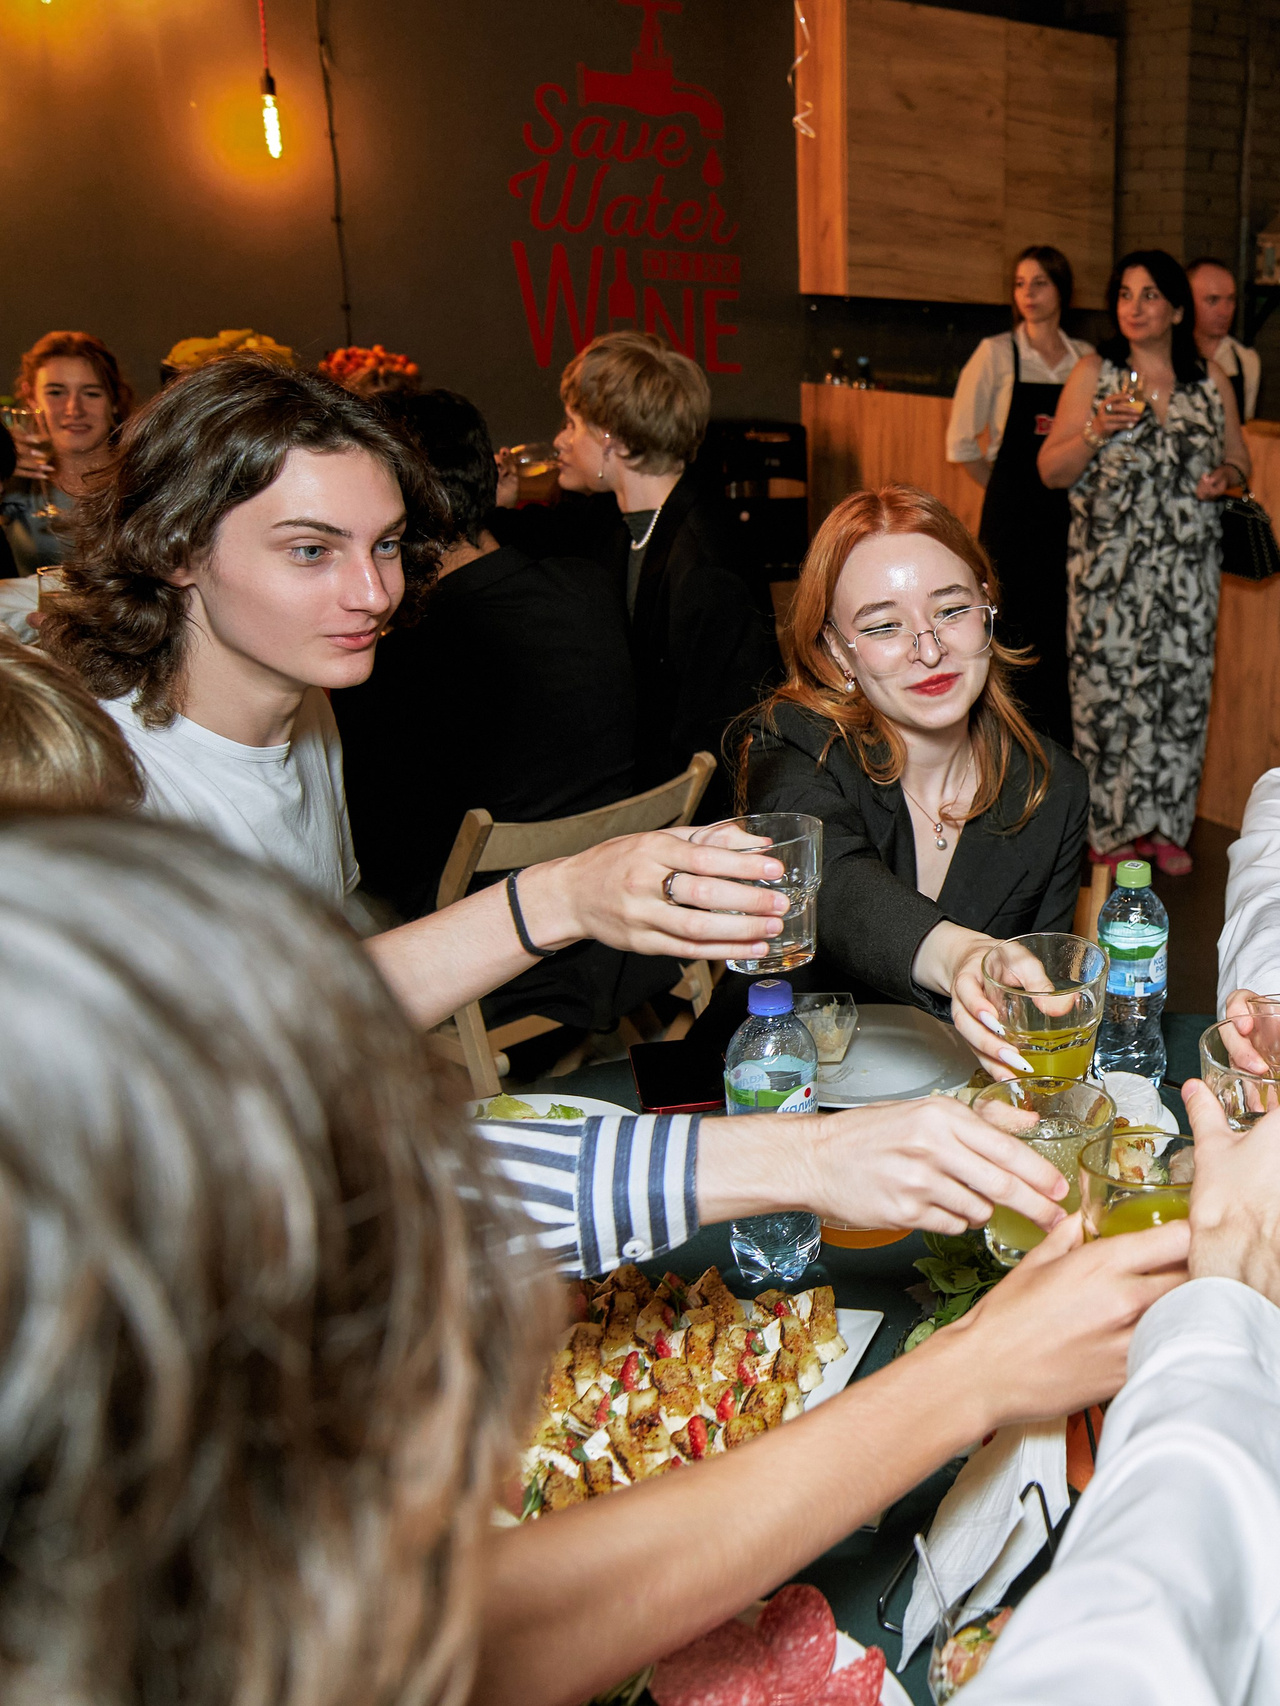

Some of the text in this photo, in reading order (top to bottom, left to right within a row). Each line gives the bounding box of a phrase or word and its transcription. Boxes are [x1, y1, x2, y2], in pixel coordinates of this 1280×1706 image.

[522, 82, 693, 169] Save
[508, 159, 740, 245] Water
[511, 239, 743, 374] WINE
[645, 252, 739, 281] DRINK
